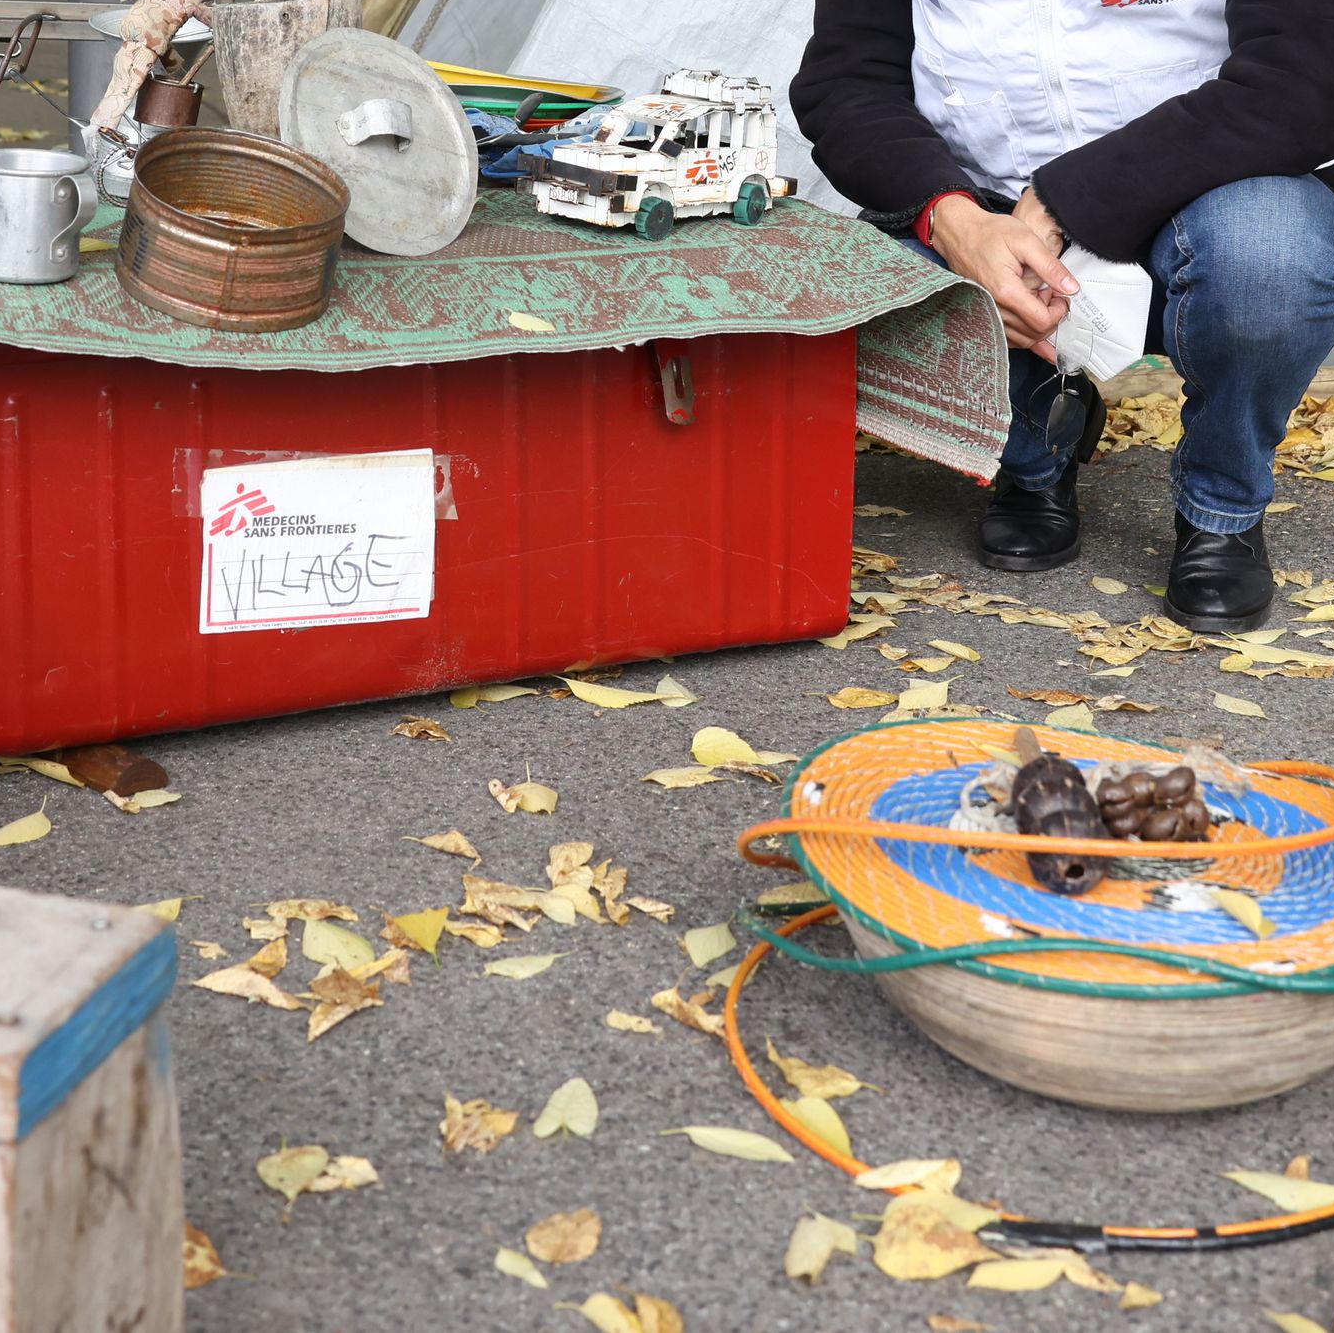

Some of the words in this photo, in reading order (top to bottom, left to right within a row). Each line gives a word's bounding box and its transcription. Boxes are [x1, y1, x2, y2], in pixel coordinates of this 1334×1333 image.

[719, 151, 736, 178] MSF
[243, 526, 276, 538] SANS
[280, 523, 357, 536] FRONTIERES
[252, 514, 316, 528] MEDECINS
[221, 533, 411, 621] VILLAGE
